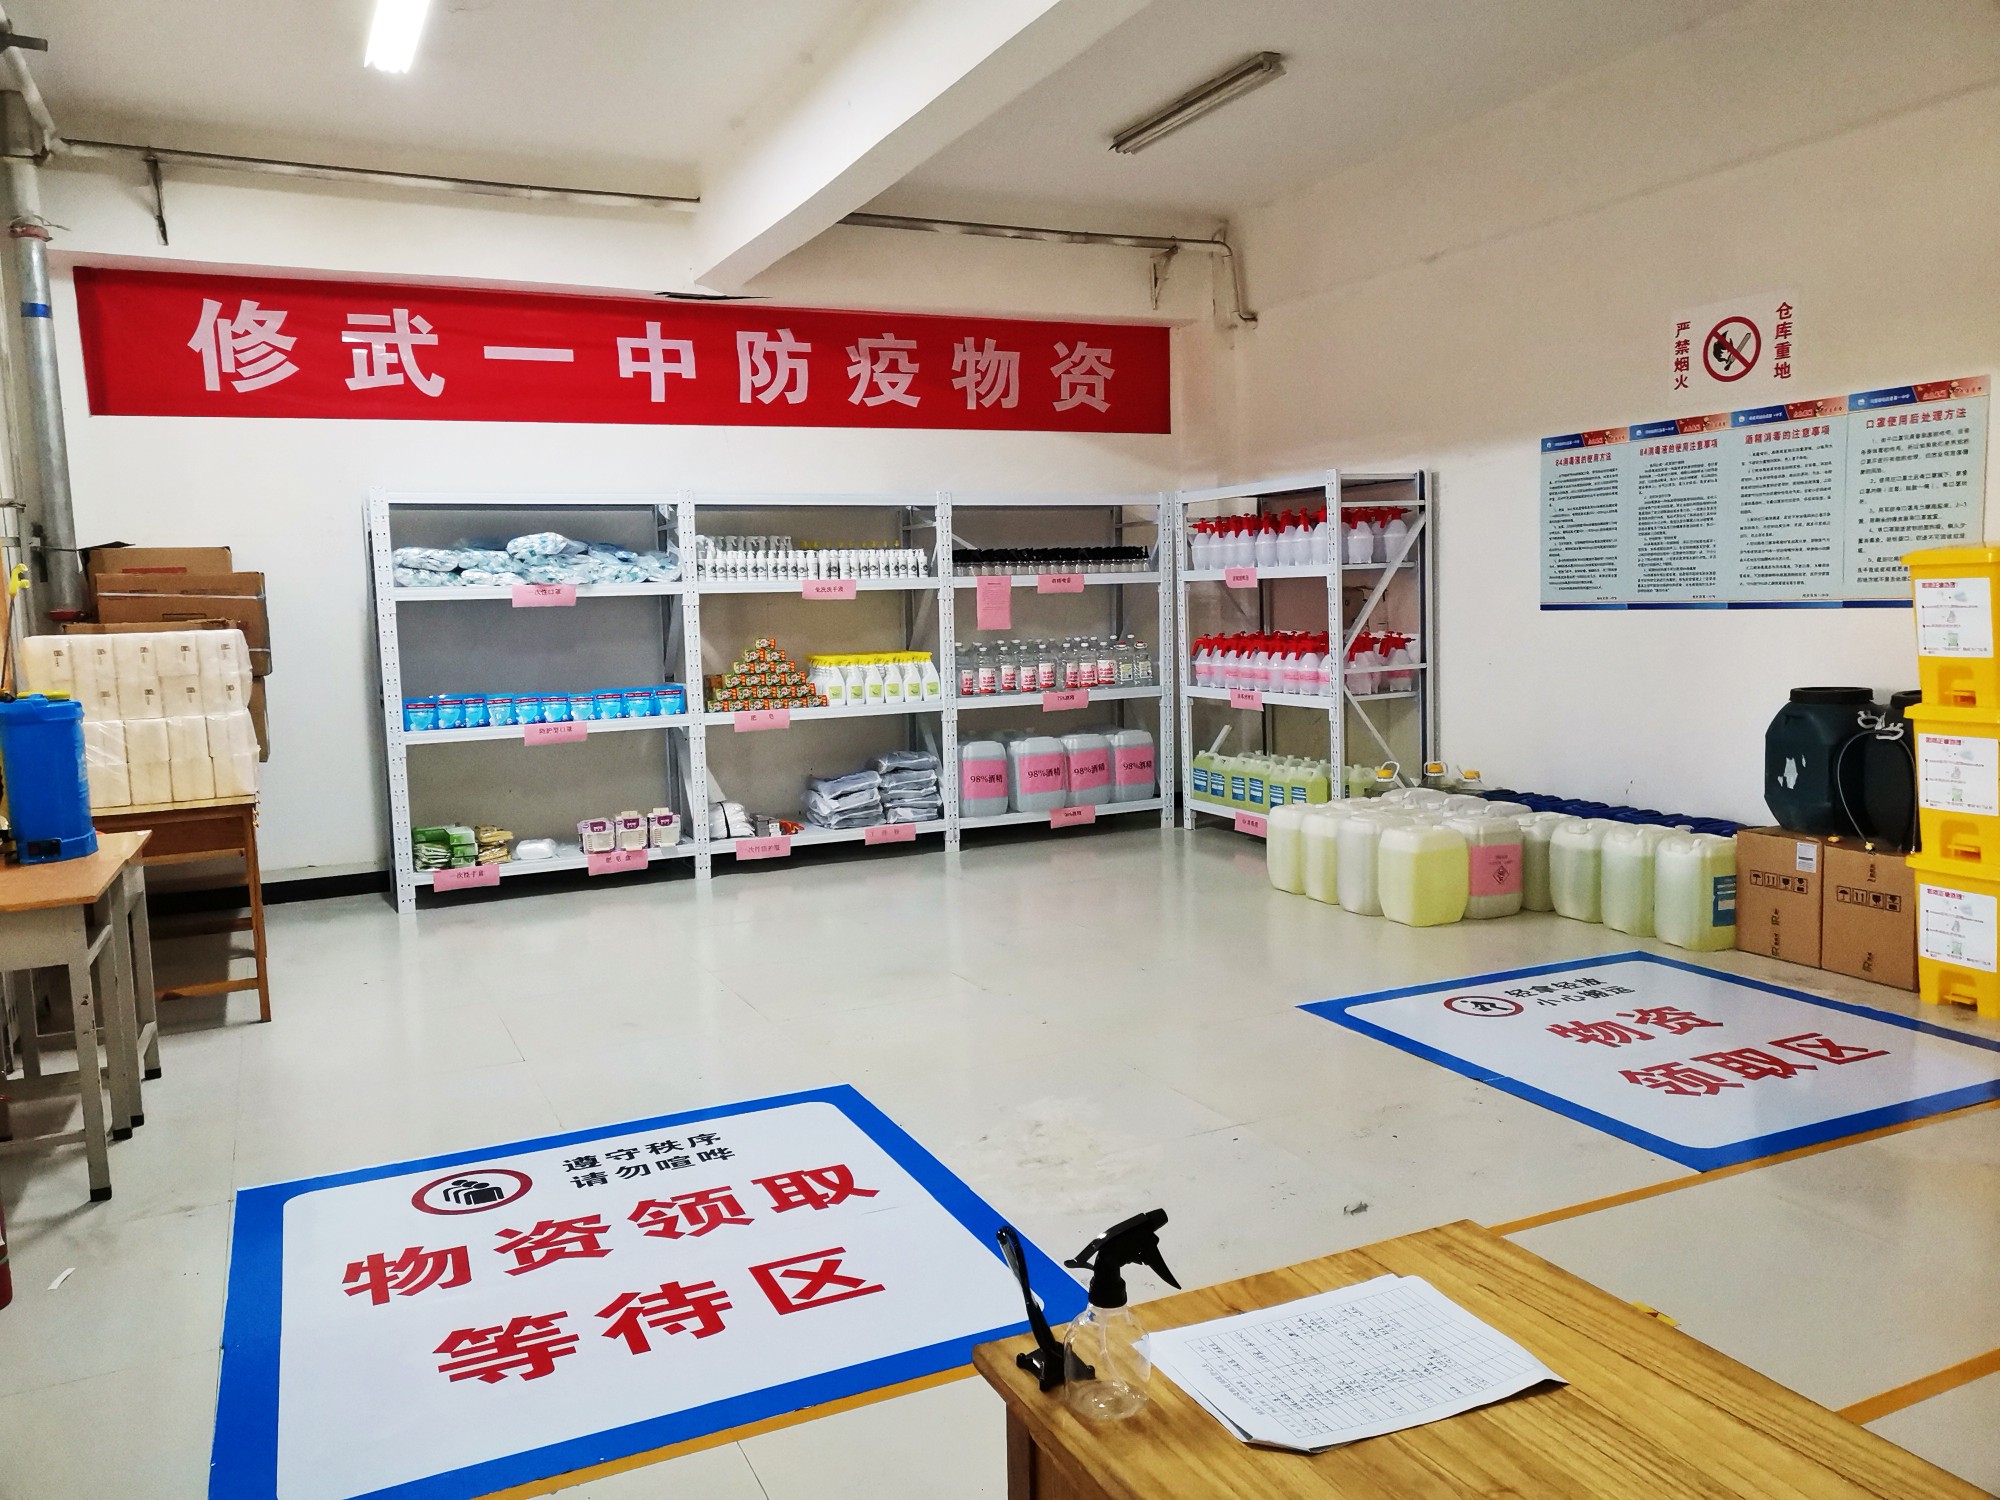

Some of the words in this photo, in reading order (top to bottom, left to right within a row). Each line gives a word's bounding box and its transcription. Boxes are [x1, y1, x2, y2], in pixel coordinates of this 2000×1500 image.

[188, 297, 1116, 414] 修武一中防疫物资
[1674, 321, 1691, 390] 严禁烟火
[1774, 302, 1793, 379] 仓库重地
[1866, 408, 1967, 429] 口罩使用后处理方法
[1639, 438, 1718, 456] 84消毒液的使用注意事项
[1745, 425, 1830, 444] 酒精消毒的注意事项
[1555, 452, 1612, 466] 84消毒液的使用方法
[970, 774, 1003, 784] 98%酒精
[1027, 767, 1061, 779] 98%酒精
[1074, 762, 1106, 776] 98%酒精
[1123, 760, 1152, 771] 98%酒精
[1505, 977, 1607, 998] 轻拿轻放
[1545, 1006, 1724, 1047] 物资
[1618, 1032, 1891, 1097] 领取区
[563, 1132, 721, 1173] 遵守秩序
[570, 1147, 736, 1189] 请勿喧哗
[342, 1163, 881, 1307] 物资领取
[431, 1246, 887, 1385] 等待区
